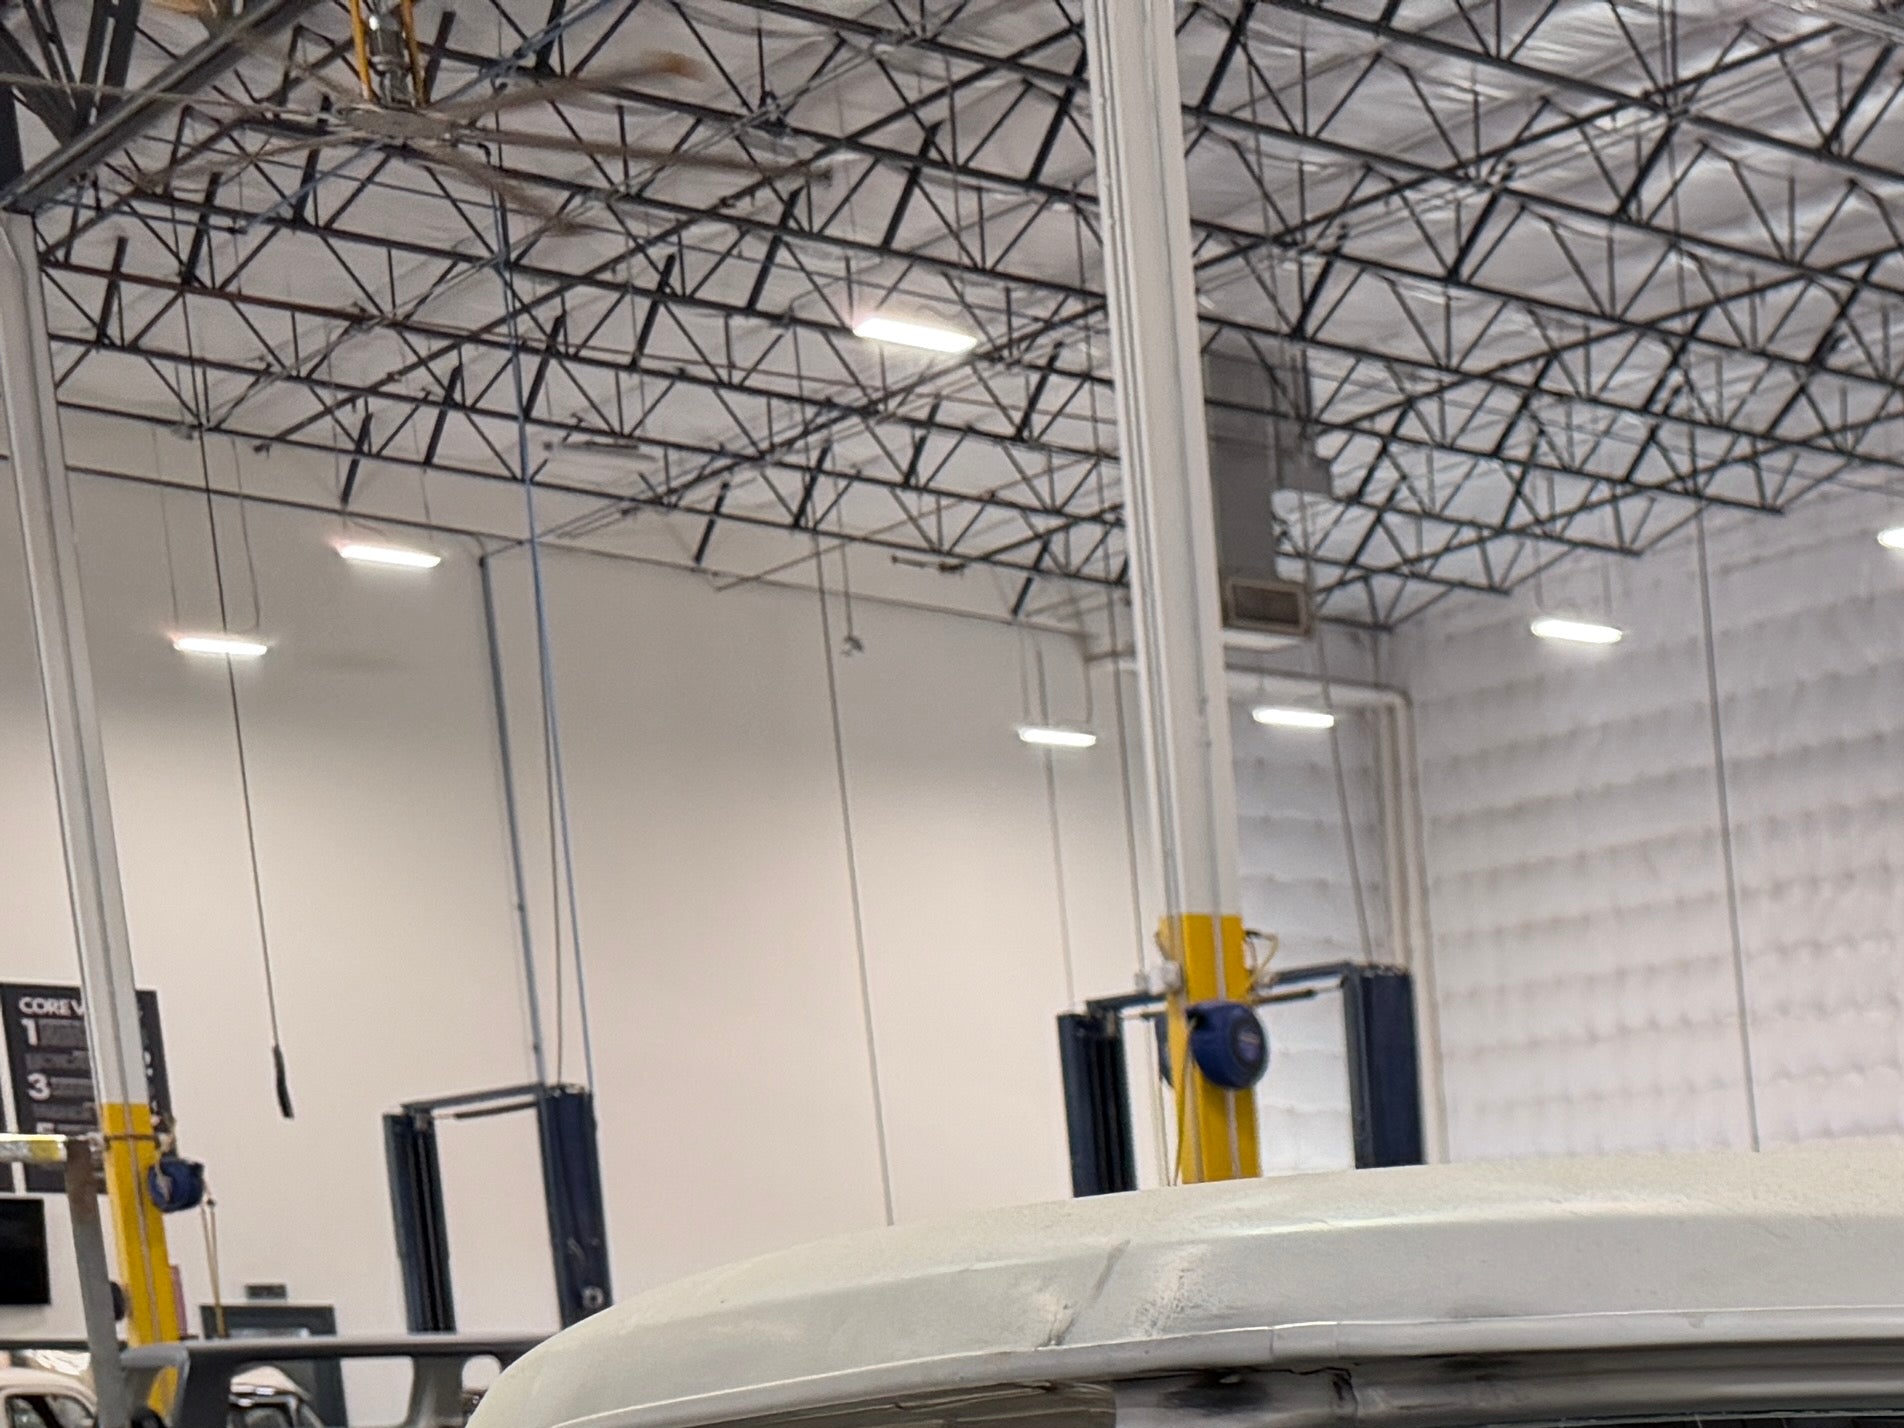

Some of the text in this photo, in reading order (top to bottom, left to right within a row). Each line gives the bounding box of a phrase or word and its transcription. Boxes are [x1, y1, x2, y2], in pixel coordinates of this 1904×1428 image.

[19, 996, 71, 1017] CORE
[21, 1018, 39, 1046] 1
[27, 1072, 50, 1100] 3
